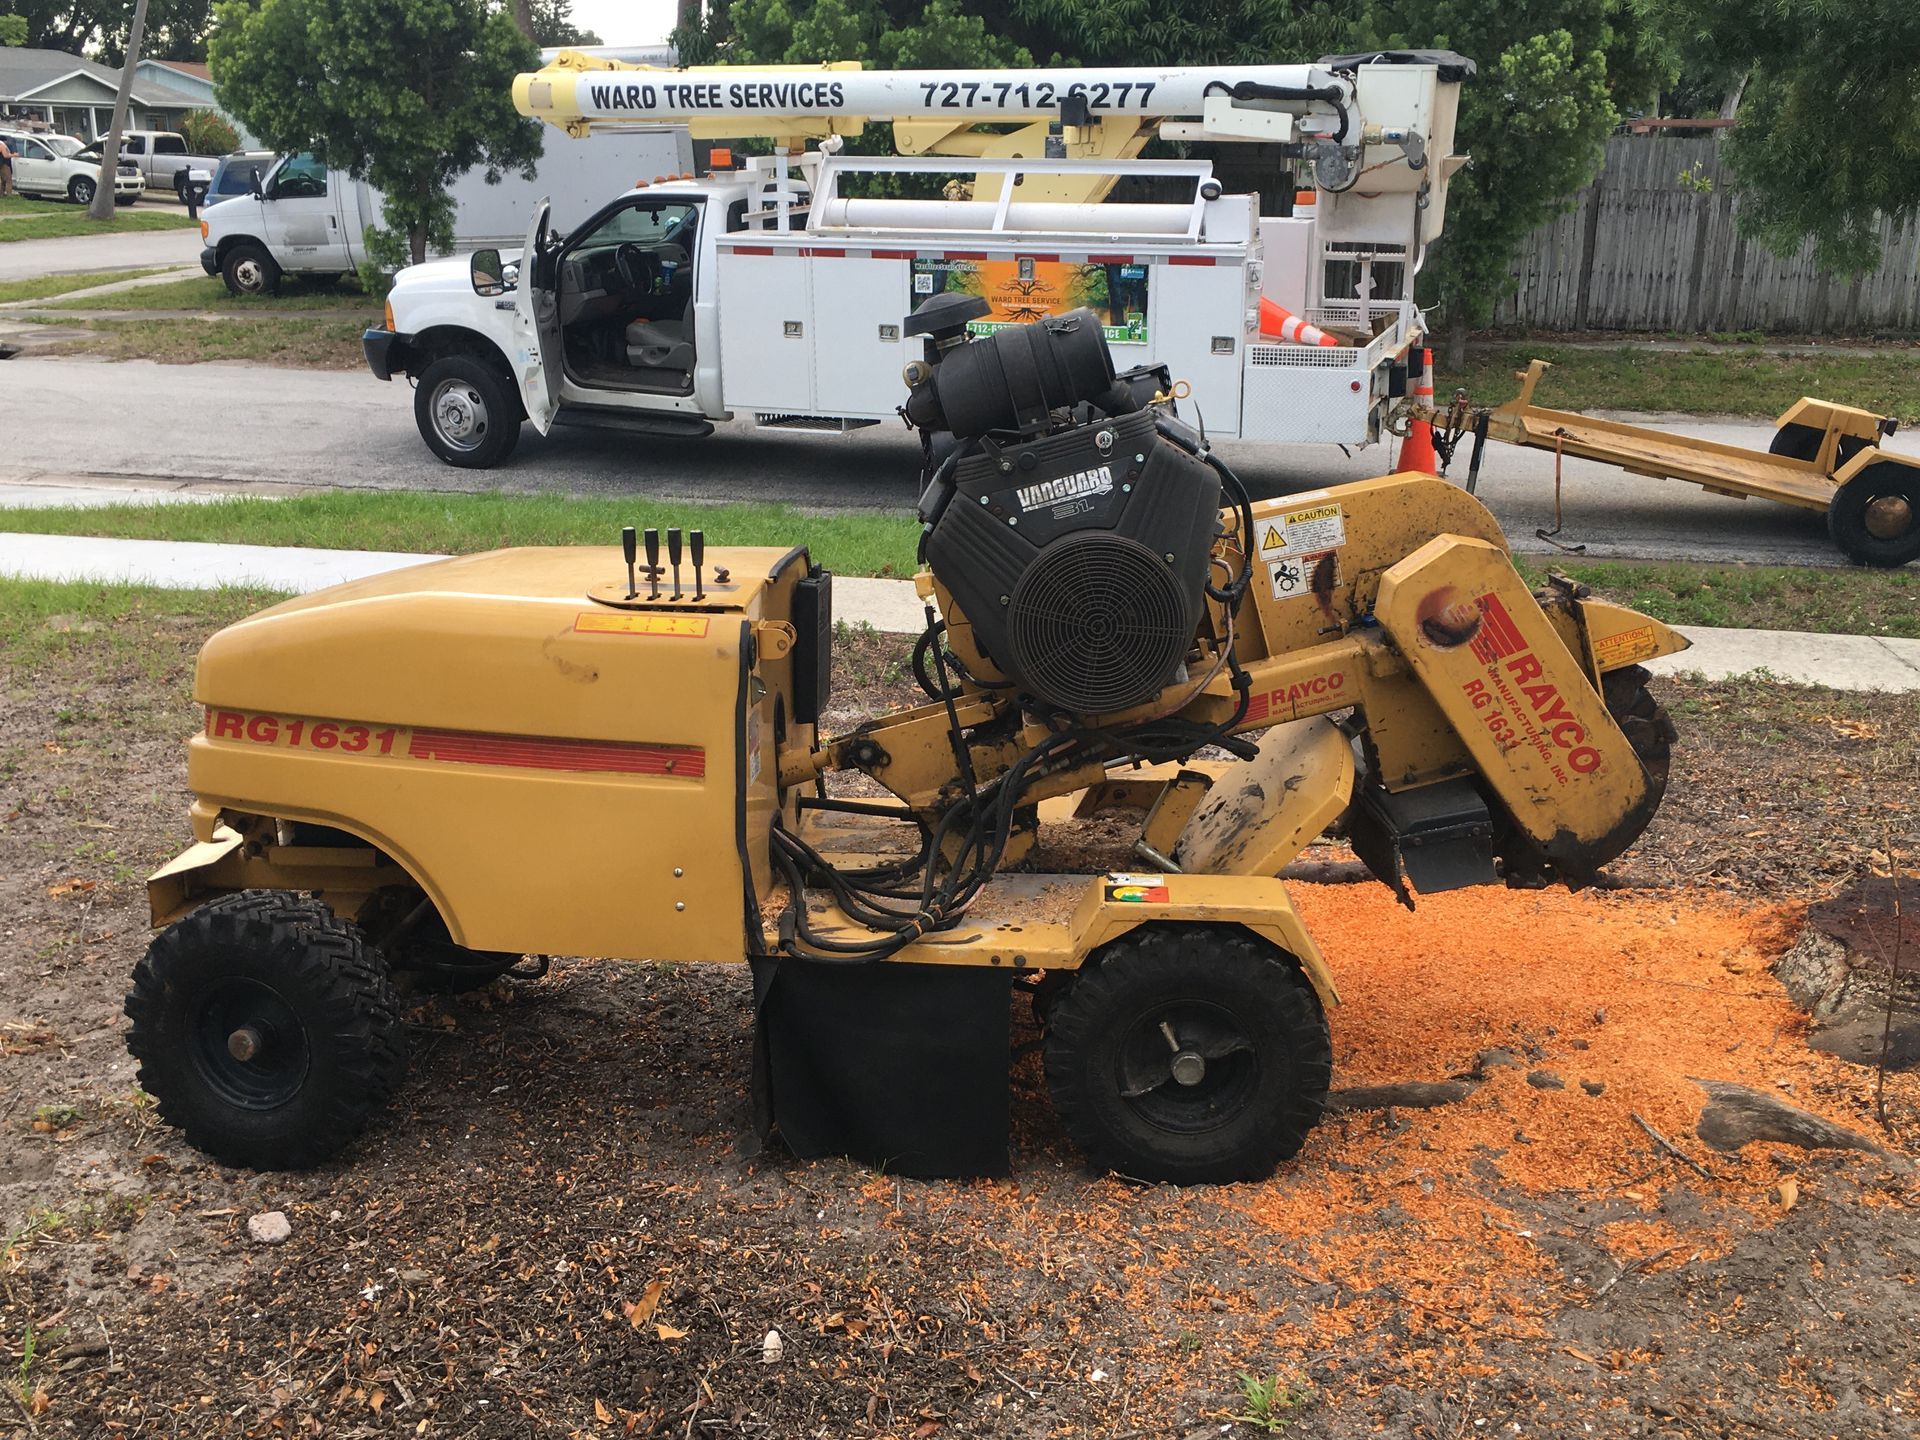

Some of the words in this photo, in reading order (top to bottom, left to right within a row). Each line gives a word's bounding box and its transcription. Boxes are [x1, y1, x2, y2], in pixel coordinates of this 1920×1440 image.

[590, 85, 657, 110] WARD
[664, 83, 724, 109] TREE
[729, 82, 845, 109] SERVICES
[919, 82, 1156, 109] 727-712-6277
[991, 295, 1012, 303] WARD
[1014, 296, 1031, 304] TREE
[1032, 297, 1061, 305] SERVICE
[1016, 466, 1112, 508] VANGUARD
[1297, 507, 1338, 522] CAUTION
[1271, 671, 1344, 706] RAYCO
[1462, 678, 1493, 710] RG
[1483, 709, 1522, 752] 1631
[1487, 667, 1553, 764] MANUFACTURING,
[1550, 764, 1569, 788] INC.
[1505, 652, 1601, 774] RAYCO
[214, 711, 397, 754] RG1631
